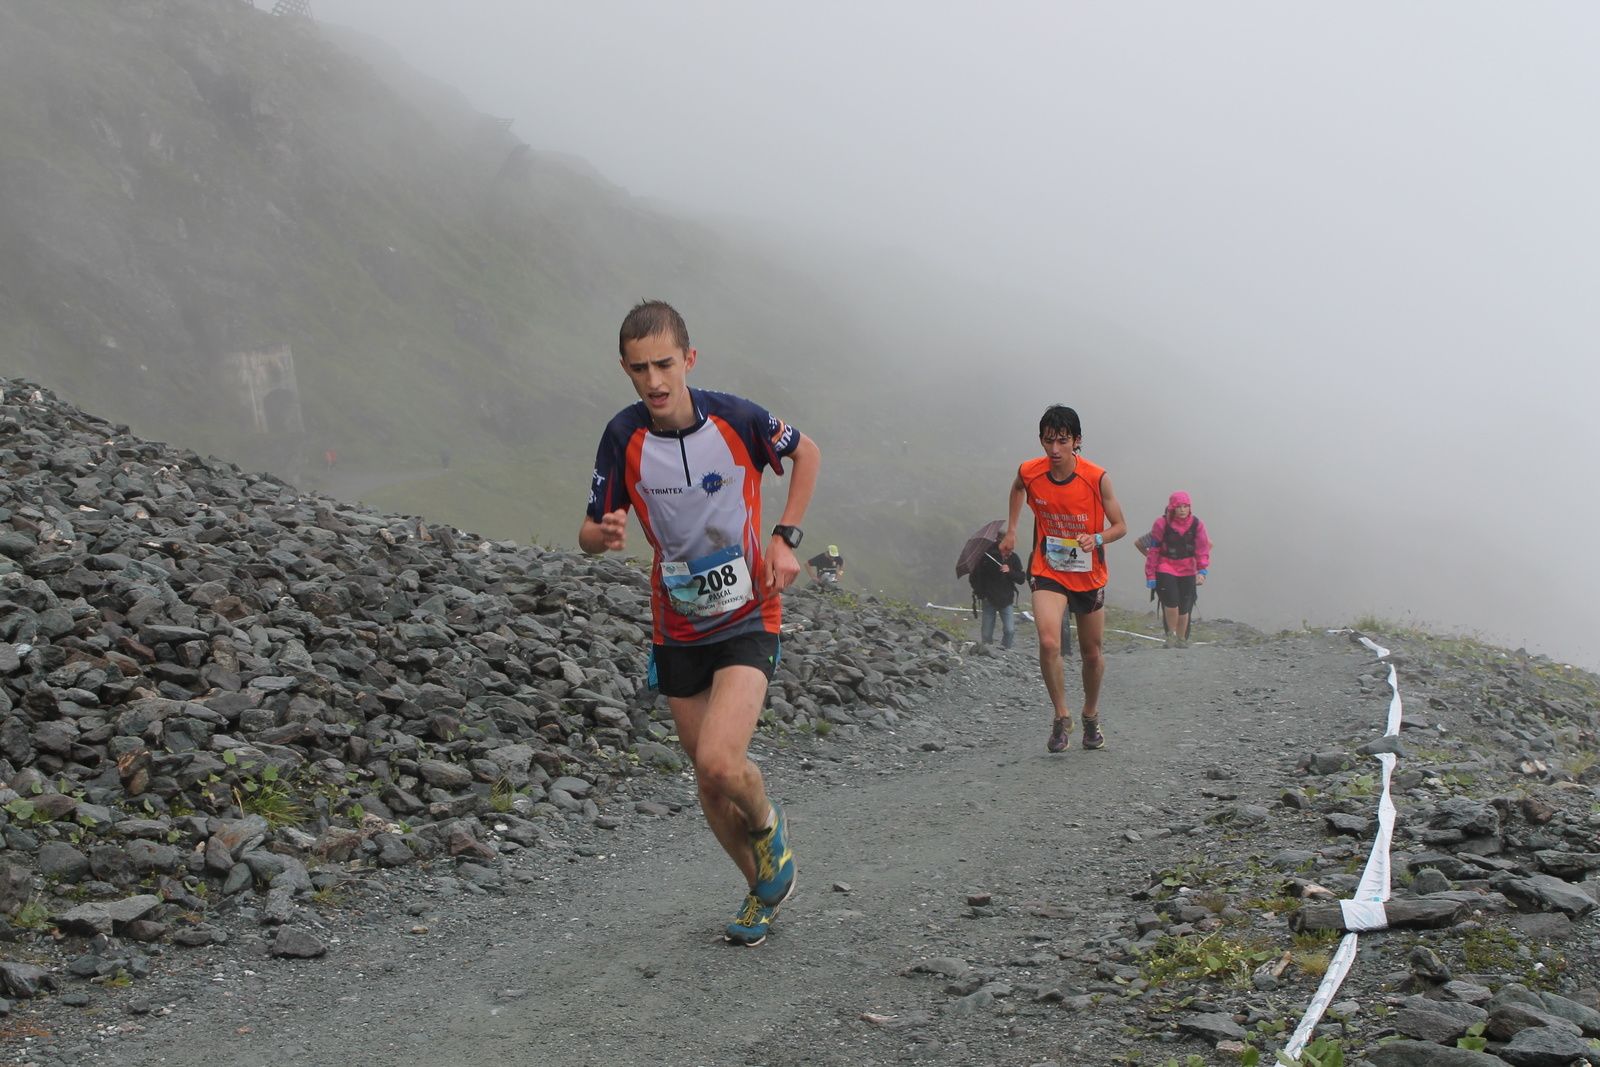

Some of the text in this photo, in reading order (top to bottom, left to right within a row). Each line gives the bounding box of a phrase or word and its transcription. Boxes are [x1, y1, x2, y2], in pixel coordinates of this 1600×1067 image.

[651, 487, 683, 495] TRIMTEX
[1077, 513, 1089, 522] DEL
[1069, 548, 1078, 560] 4
[693, 564, 738, 596] 208
[707, 589, 732, 602] PASCAL
